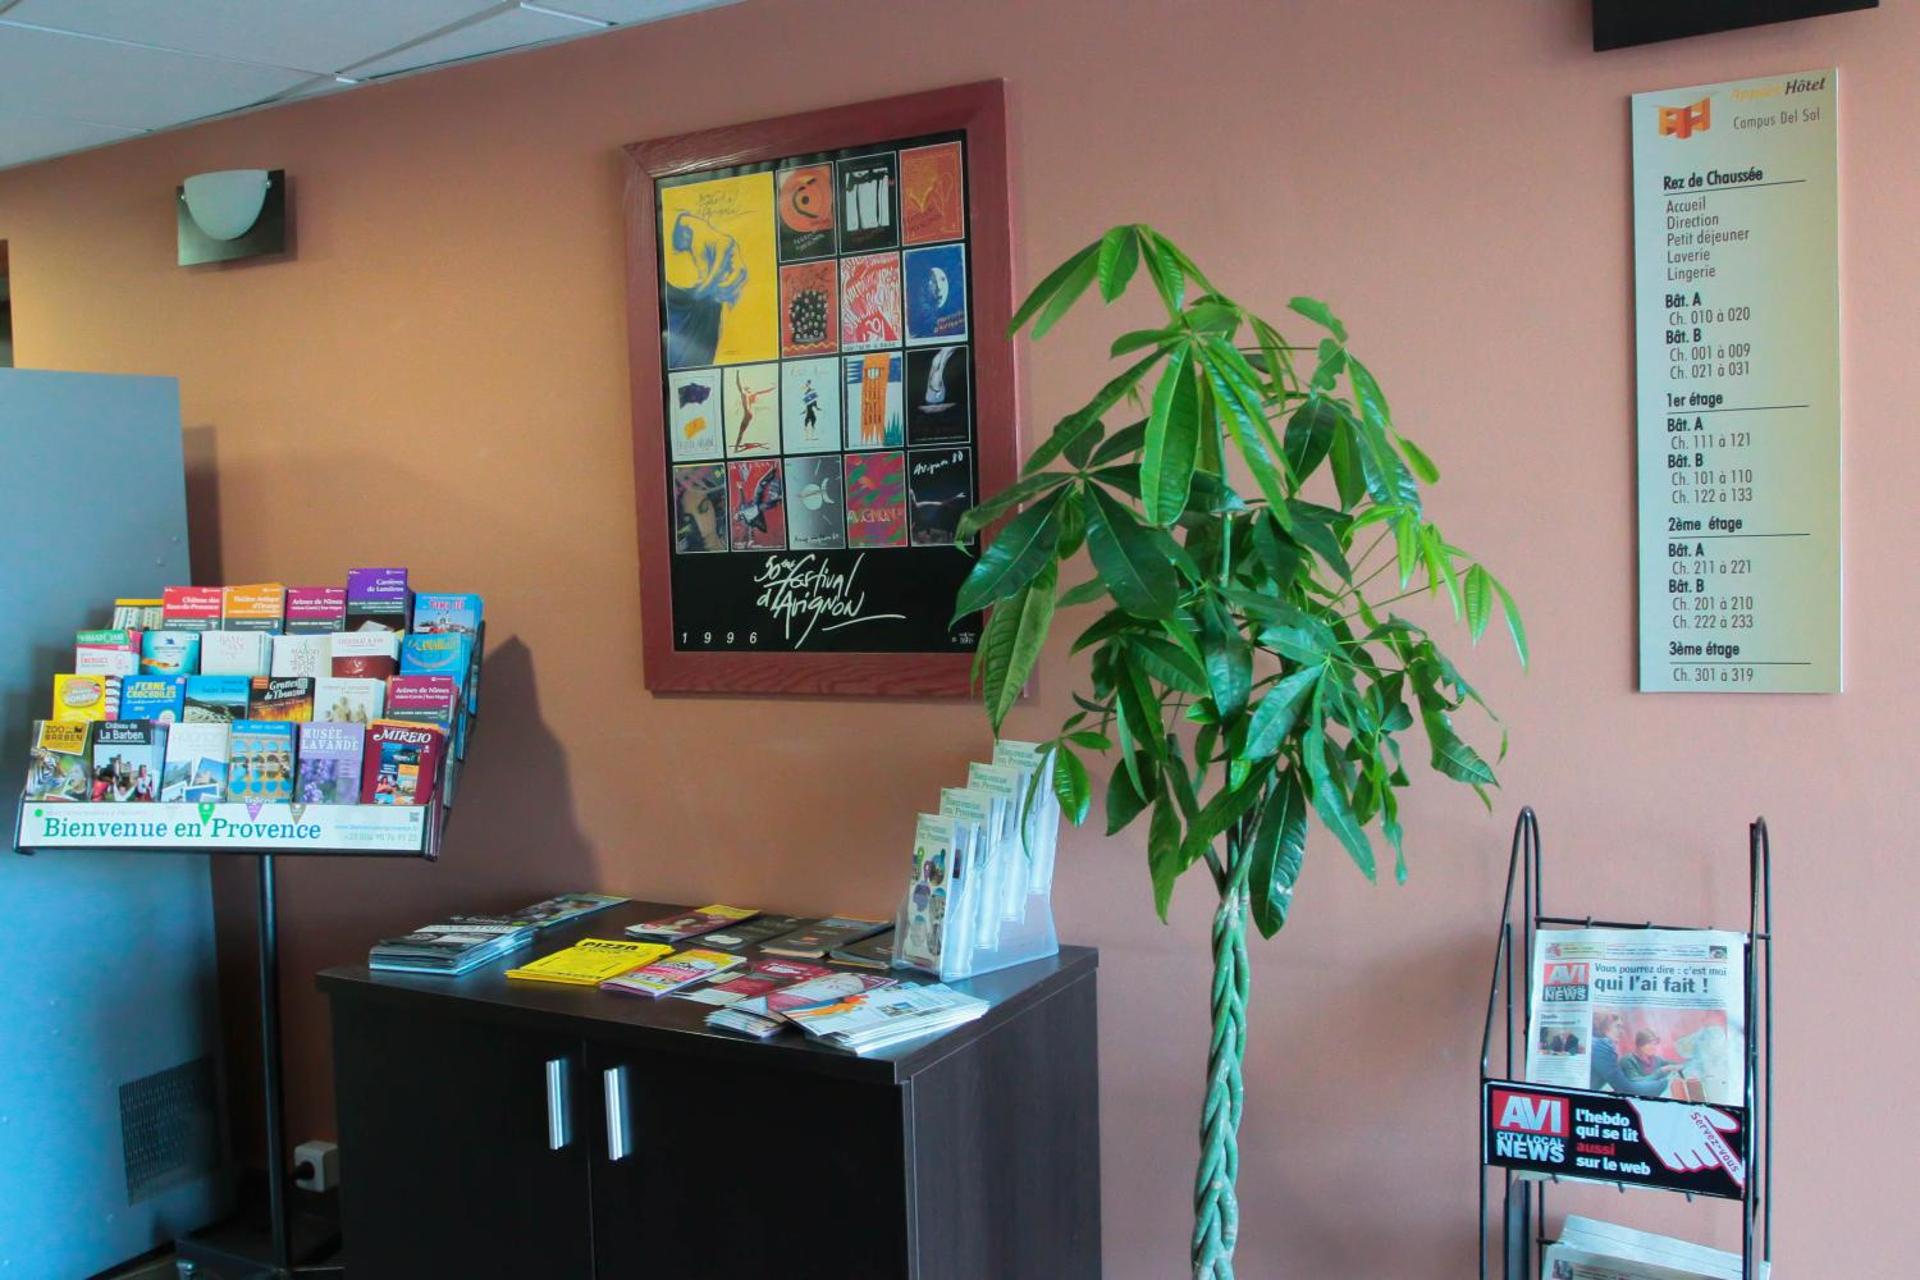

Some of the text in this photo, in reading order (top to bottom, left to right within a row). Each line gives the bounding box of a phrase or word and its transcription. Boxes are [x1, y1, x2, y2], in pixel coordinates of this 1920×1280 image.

[1785, 77, 1825, 95] Hôtel
[1733, 107, 1820, 130] Campus Del Sol
[1663, 167, 1763, 190] Rez de Chaussée
[1666, 196, 1706, 213] Accueil
[1667, 213, 1719, 229] Direction
[1667, 229, 1750, 247] Petit déjeuner
[1667, 248, 1711, 264] Laverie
[1667, 265, 1716, 282] Lingerie
[1665, 291, 1701, 308] Bât. A
[1669, 307, 1750, 325] Ch. 010 à 020
[1666, 328, 1702, 344] Bât. B
[1670, 343, 1750, 361] Ch. 001 à 009
[1670, 361, 1749, 379] Ch. 021 à 031
[1667, 392, 1723, 408] 1er étage
[1667, 416, 1703, 432] Bât. A
[1671, 432, 1750, 449] Ch. 111 à 121
[1668, 453, 1704, 468] Bât. B
[1671, 469, 1752, 485] Ch. 101 à 110
[1672, 487, 1752, 504] Ch. 122 à 133
[1668, 516, 1743, 533] 2ème étage
[1668, 542, 1704, 557] Bât. A
[1672, 559, 1751, 575] Ch. 211 à 221
[1668, 578, 1704, 593] Bât. B
[1673, 596, 1753, 611] Ch. 201 à 210
[1673, 614, 1753, 629] Ch. 222 à 233
[1669, 640, 1740, 658] 3ème étage
[1673, 667, 1753, 681] Ch. 301 à 319
[100, 730, 144, 740] La Barben
[304, 726, 343, 740] MUSÉE
[373, 728, 432, 744] MIREIO
[302, 739, 359, 752] LAVANDE
[43, 817, 167, 838] Bienvenue
[175, 823, 202, 838] en
[211, 818, 321, 839] Provence
[1549, 964, 1586, 984] AVI
[1595, 963, 1617, 973] Vous
[1619, 965, 1654, 976] pourrez
[1656, 965, 1676, 975] dire
[1683, 966, 1706, 976] c'est
[1709, 967, 1727, 977] moi
[1594, 975, 1708, 993] qui l'ai fait !
[1545, 988, 1586, 1000] NEWS
[1500, 1095, 1562, 1133] AVI
[1575, 1108, 1630, 1127] l'hebdo
[1496, 1131, 1563, 1149] CITY LOCAL
[1575, 1125, 1639, 1143] qui se lit
[1690, 1111, 1740, 1174] Servez-vous
[1496, 1140, 1565, 1163] NEWS
[1576, 1143, 1616, 1156] aussi
[1576, 1157, 1651, 1176] sur le web
